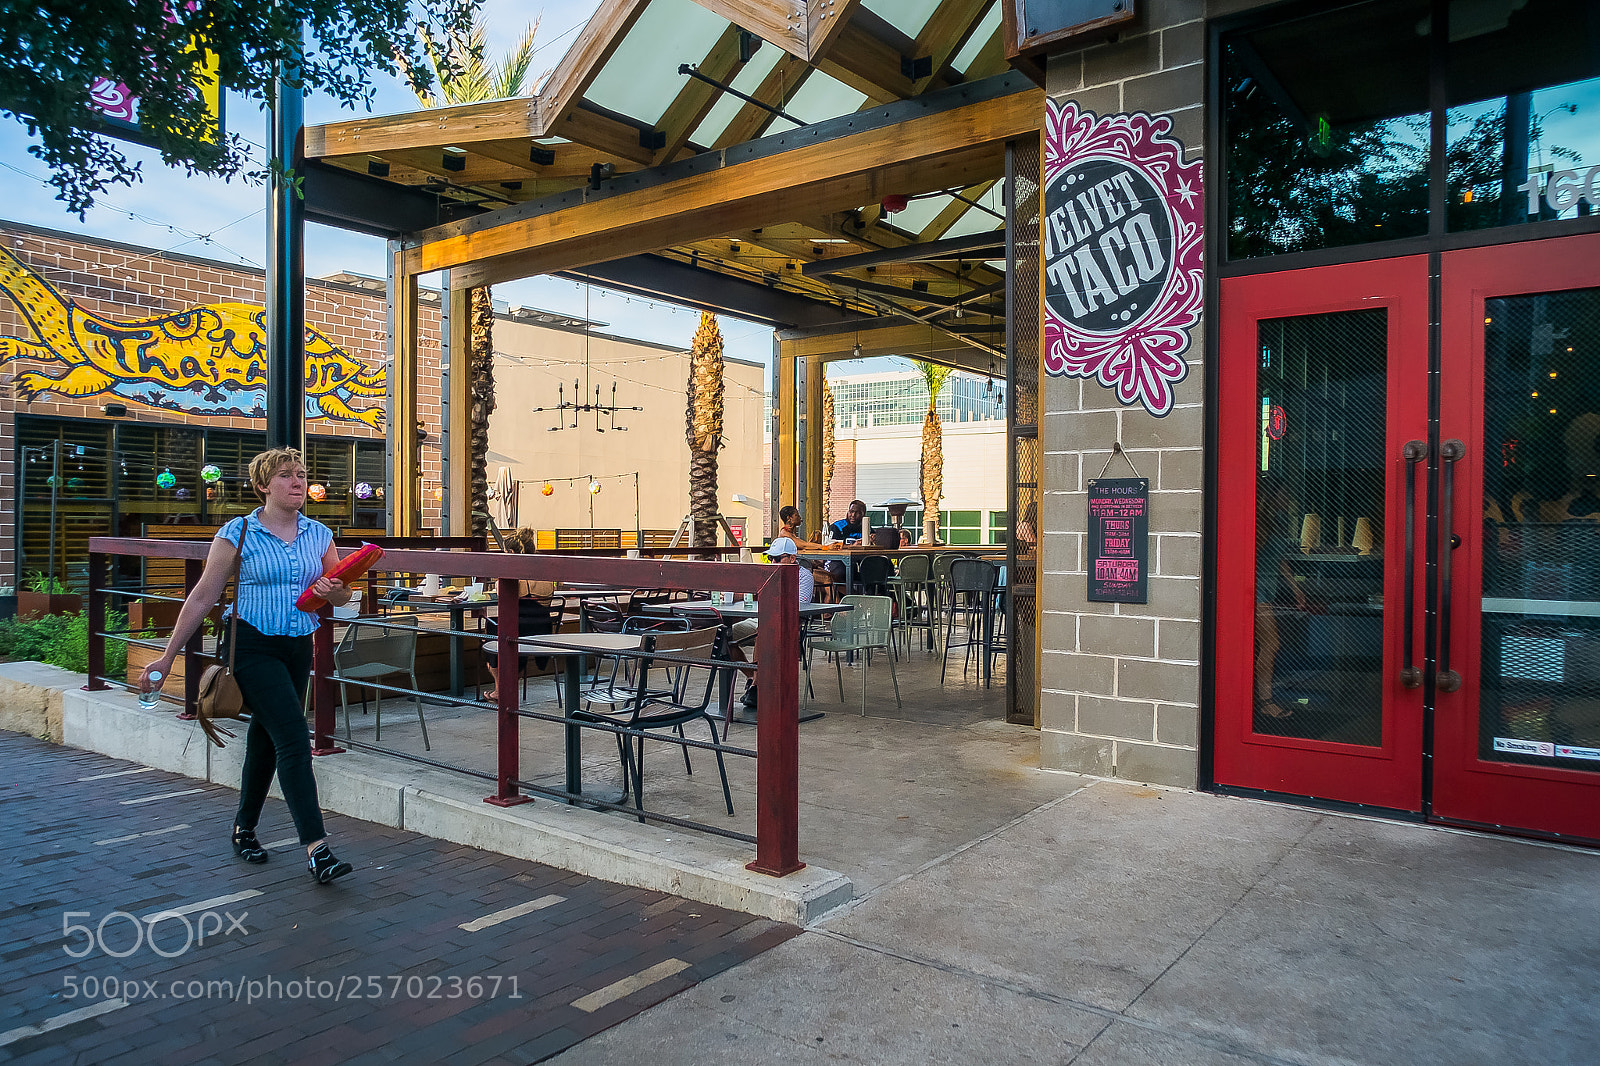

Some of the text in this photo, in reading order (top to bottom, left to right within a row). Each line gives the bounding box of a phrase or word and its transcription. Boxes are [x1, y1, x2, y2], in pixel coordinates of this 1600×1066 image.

[1046, 212, 1166, 319] TACO
[1112, 486, 1138, 495] HOURS
[1105, 520, 1130, 529] THURS
[1105, 538, 1131, 547] FRIDAY
[1097, 560, 1138, 568] SATURDAY
